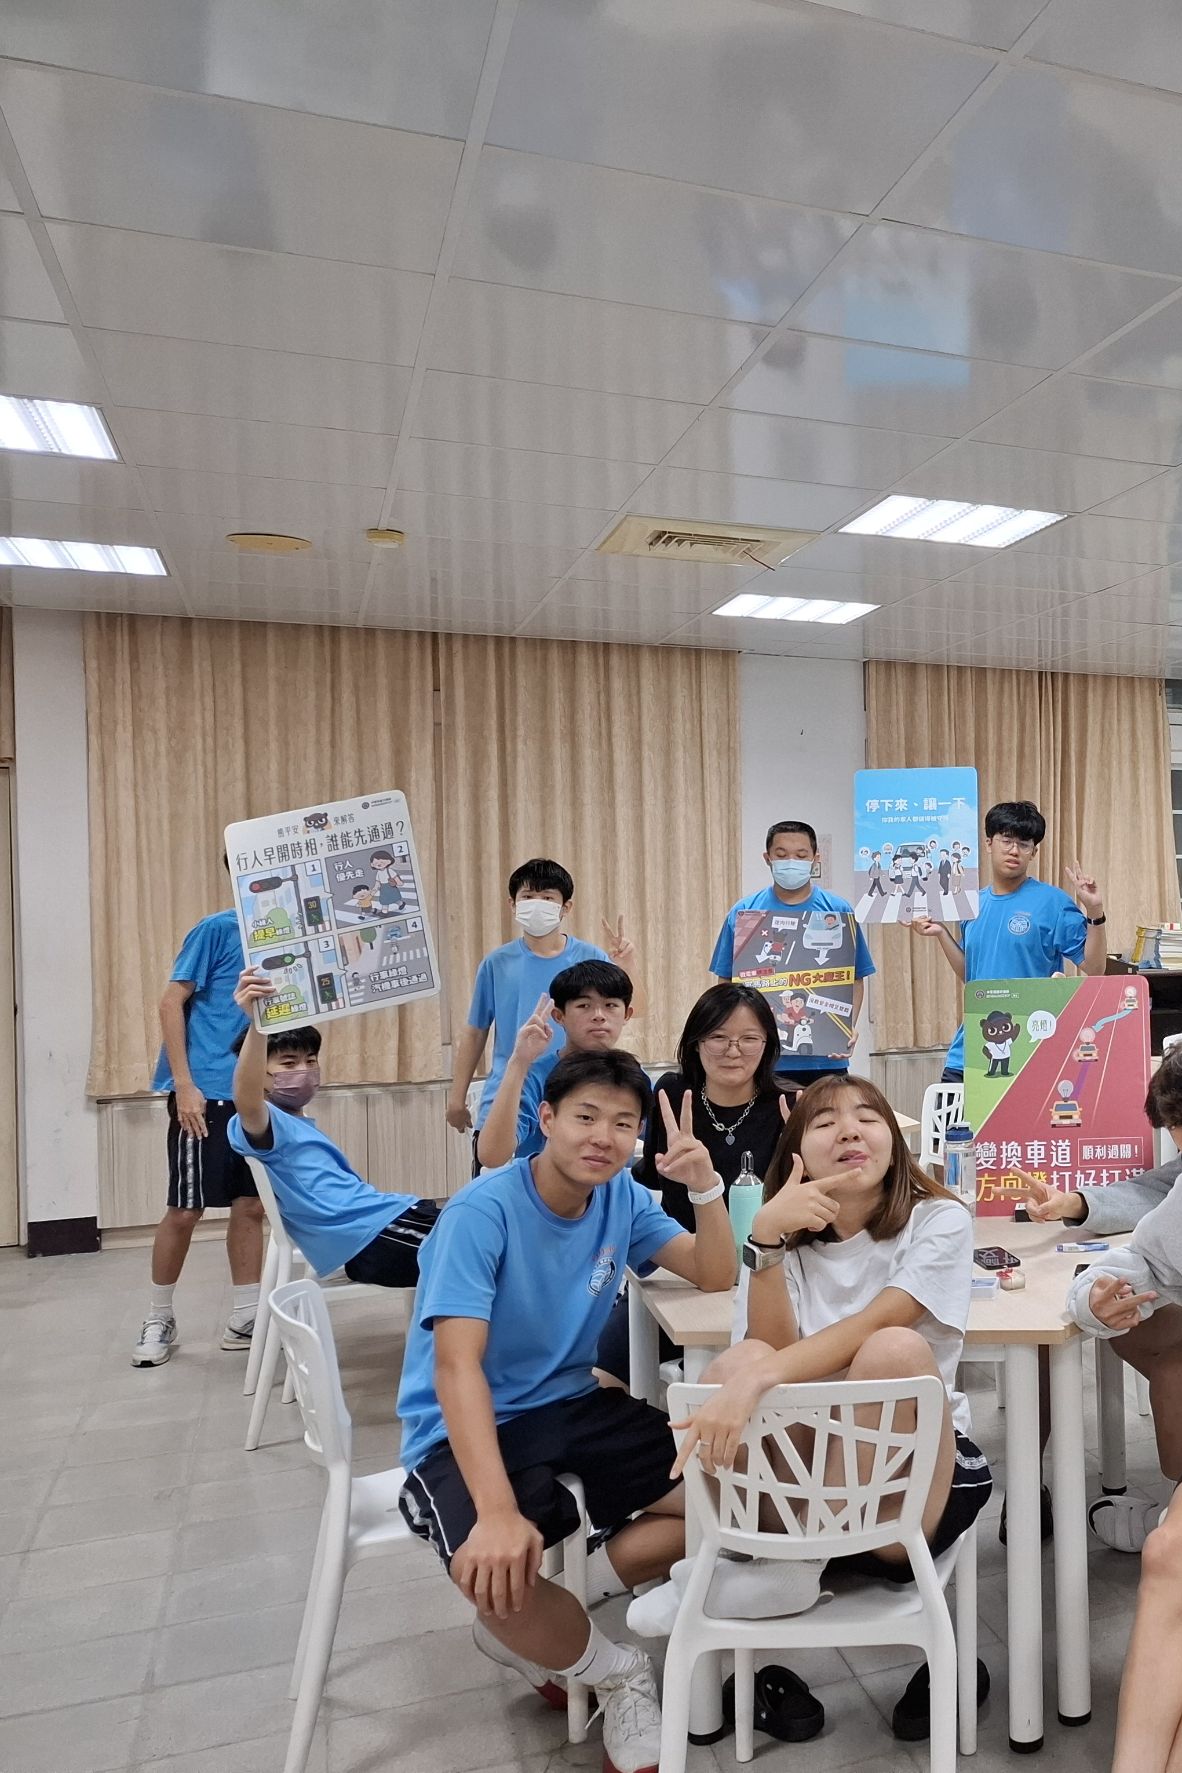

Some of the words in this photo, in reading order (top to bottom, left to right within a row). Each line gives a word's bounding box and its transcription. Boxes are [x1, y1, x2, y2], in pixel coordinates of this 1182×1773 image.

[236, 820, 405, 872] 行人早開時相，誰能先通過？
[398, 845, 403, 853] 2
[334, 860, 353, 871] 行人
[336, 868, 365, 882] 優先走
[308, 901, 317, 909] 30
[975, 1139, 1071, 1171] 變換車道
[1082, 1143, 1138, 1160] 順利過關！
